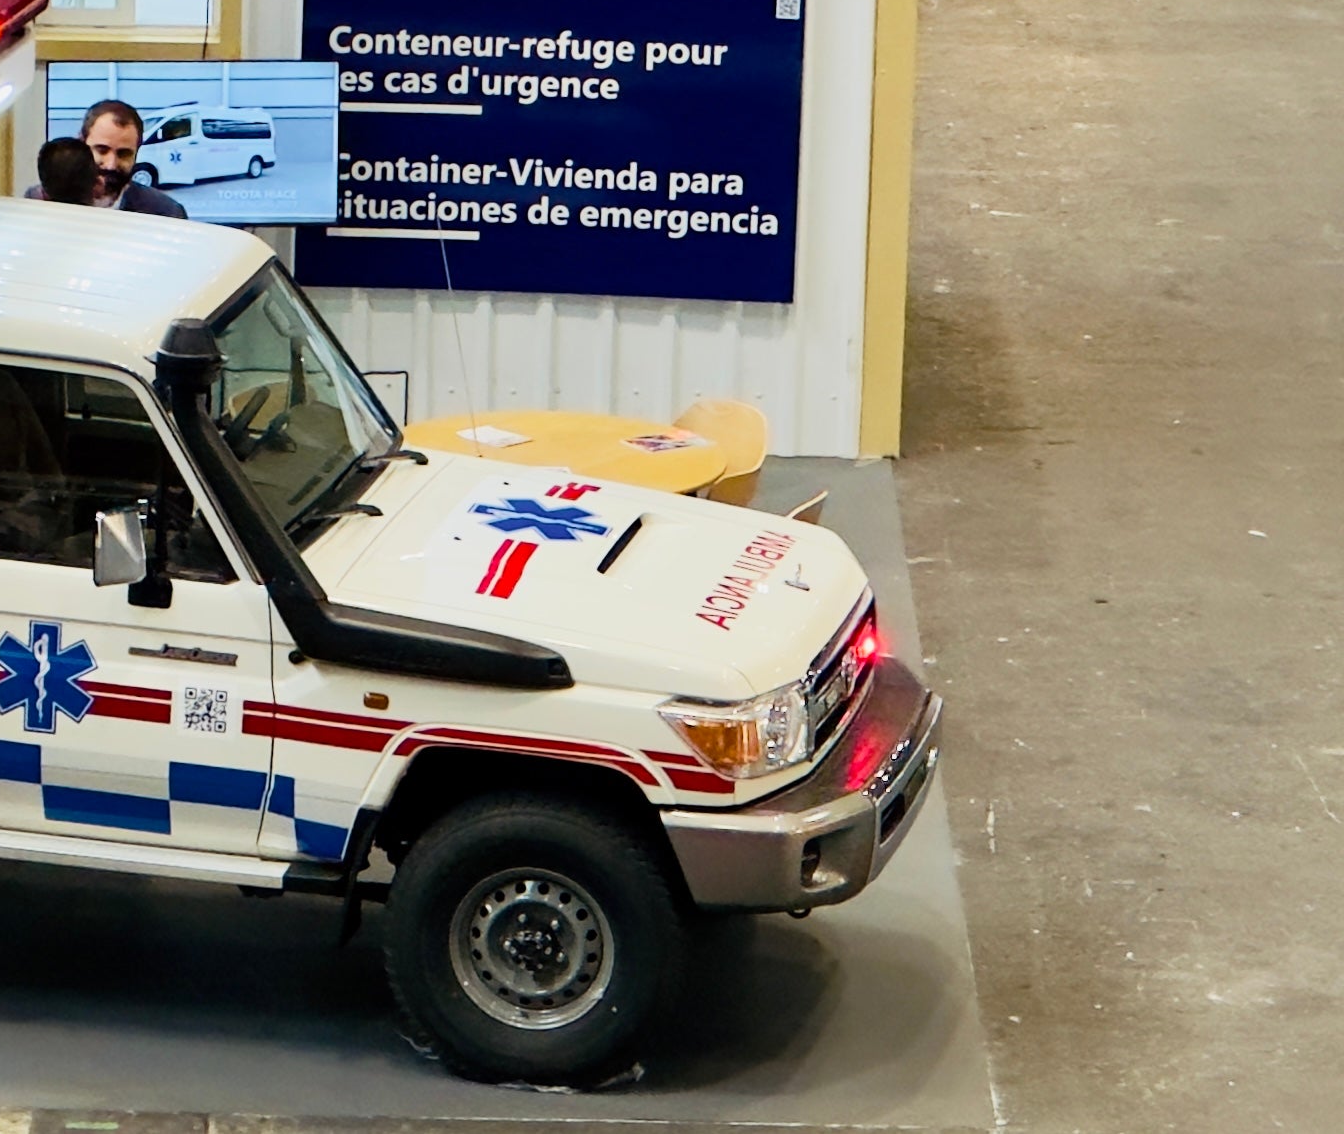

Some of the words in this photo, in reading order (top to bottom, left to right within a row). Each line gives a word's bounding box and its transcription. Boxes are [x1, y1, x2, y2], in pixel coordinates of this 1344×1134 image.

[328, 26, 636, 70] Conteneur-refuge
[645, 35, 728, 72] pour
[339, 69, 374, 93] es
[383, 71, 438, 95] cas
[447, 65, 620, 105] d'urgence
[217, 189, 263, 200] TOYOTA
[668, 168, 744, 200] para
[339, 190, 518, 224] ituaciones
[527, 196, 570, 226] de
[580, 203, 780, 240] emergencia
